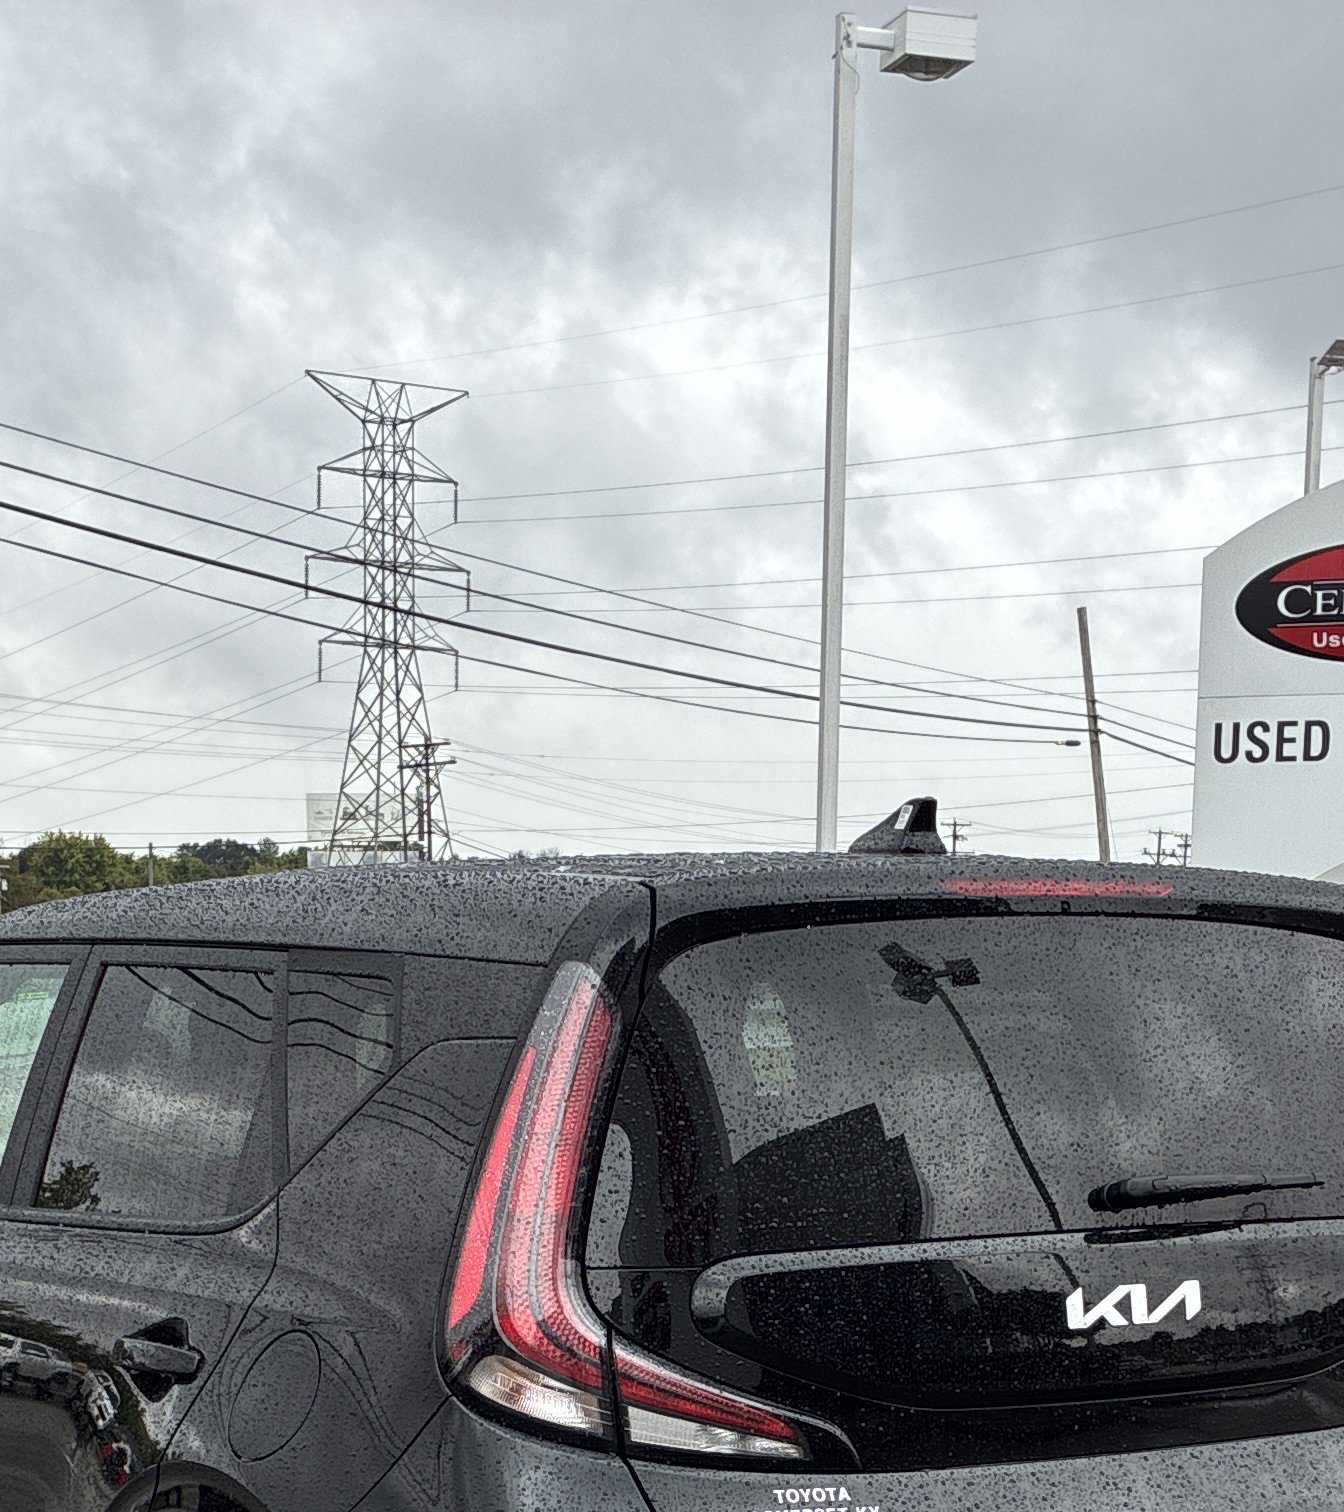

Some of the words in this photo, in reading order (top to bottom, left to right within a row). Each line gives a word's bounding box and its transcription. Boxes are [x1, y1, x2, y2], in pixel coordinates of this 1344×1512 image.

[1213, 720, 1330, 764] USED
[1065, 1279, 1202, 1330] KIA
[773, 1487, 852, 1504] TOYOTA
